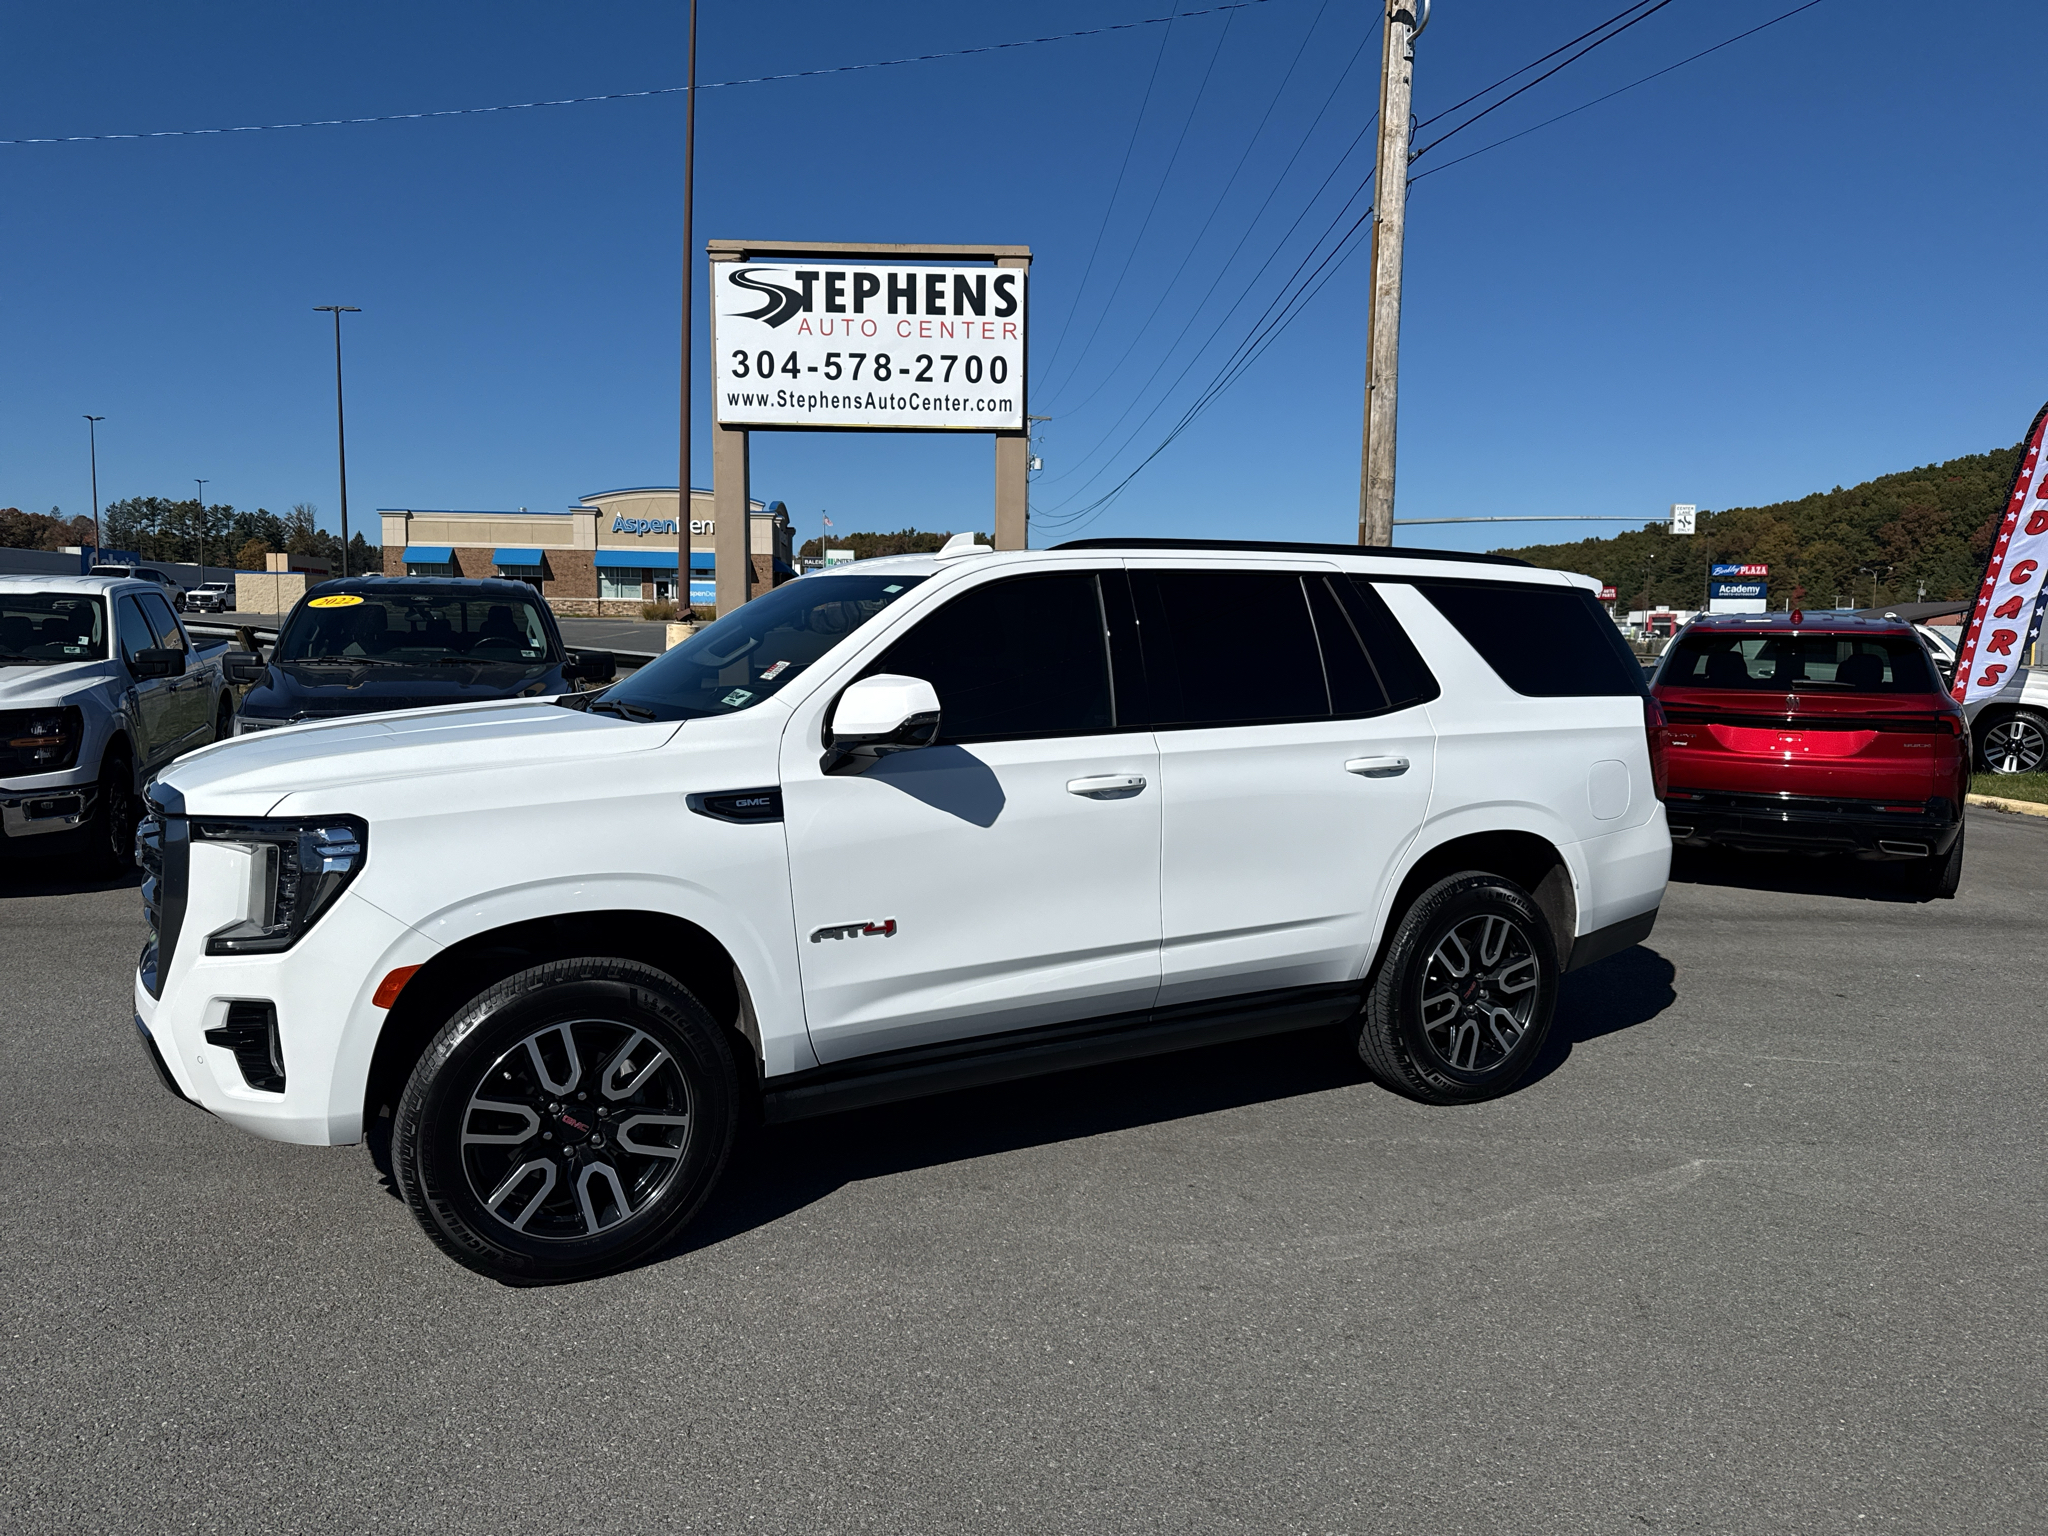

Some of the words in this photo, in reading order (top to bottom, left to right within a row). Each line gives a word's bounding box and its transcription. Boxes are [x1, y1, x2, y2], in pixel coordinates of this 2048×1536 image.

[722, 267, 1018, 329] STEPHENS
[798, 318, 877, 338] AUTO
[897, 319, 1018, 341] CENTER
[731, 349, 1008, 384] 304-578-2700
[727, 389, 1013, 413] www.StephensAutoCenter.com
[1740, 566, 1767, 575] PLAZA
[1719, 584, 1760, 595] Academy
[316, 597, 355, 606] 2022
[1977, 559, 2038, 687] CARS
[735, 797, 770, 807] GMC
[811, 919, 897, 943] AT4
[1432, 1075, 1472, 1095] ICHELIN
[562, 1114, 589, 1133] GMC
[436, 1203, 501, 1260] MICHELIN
